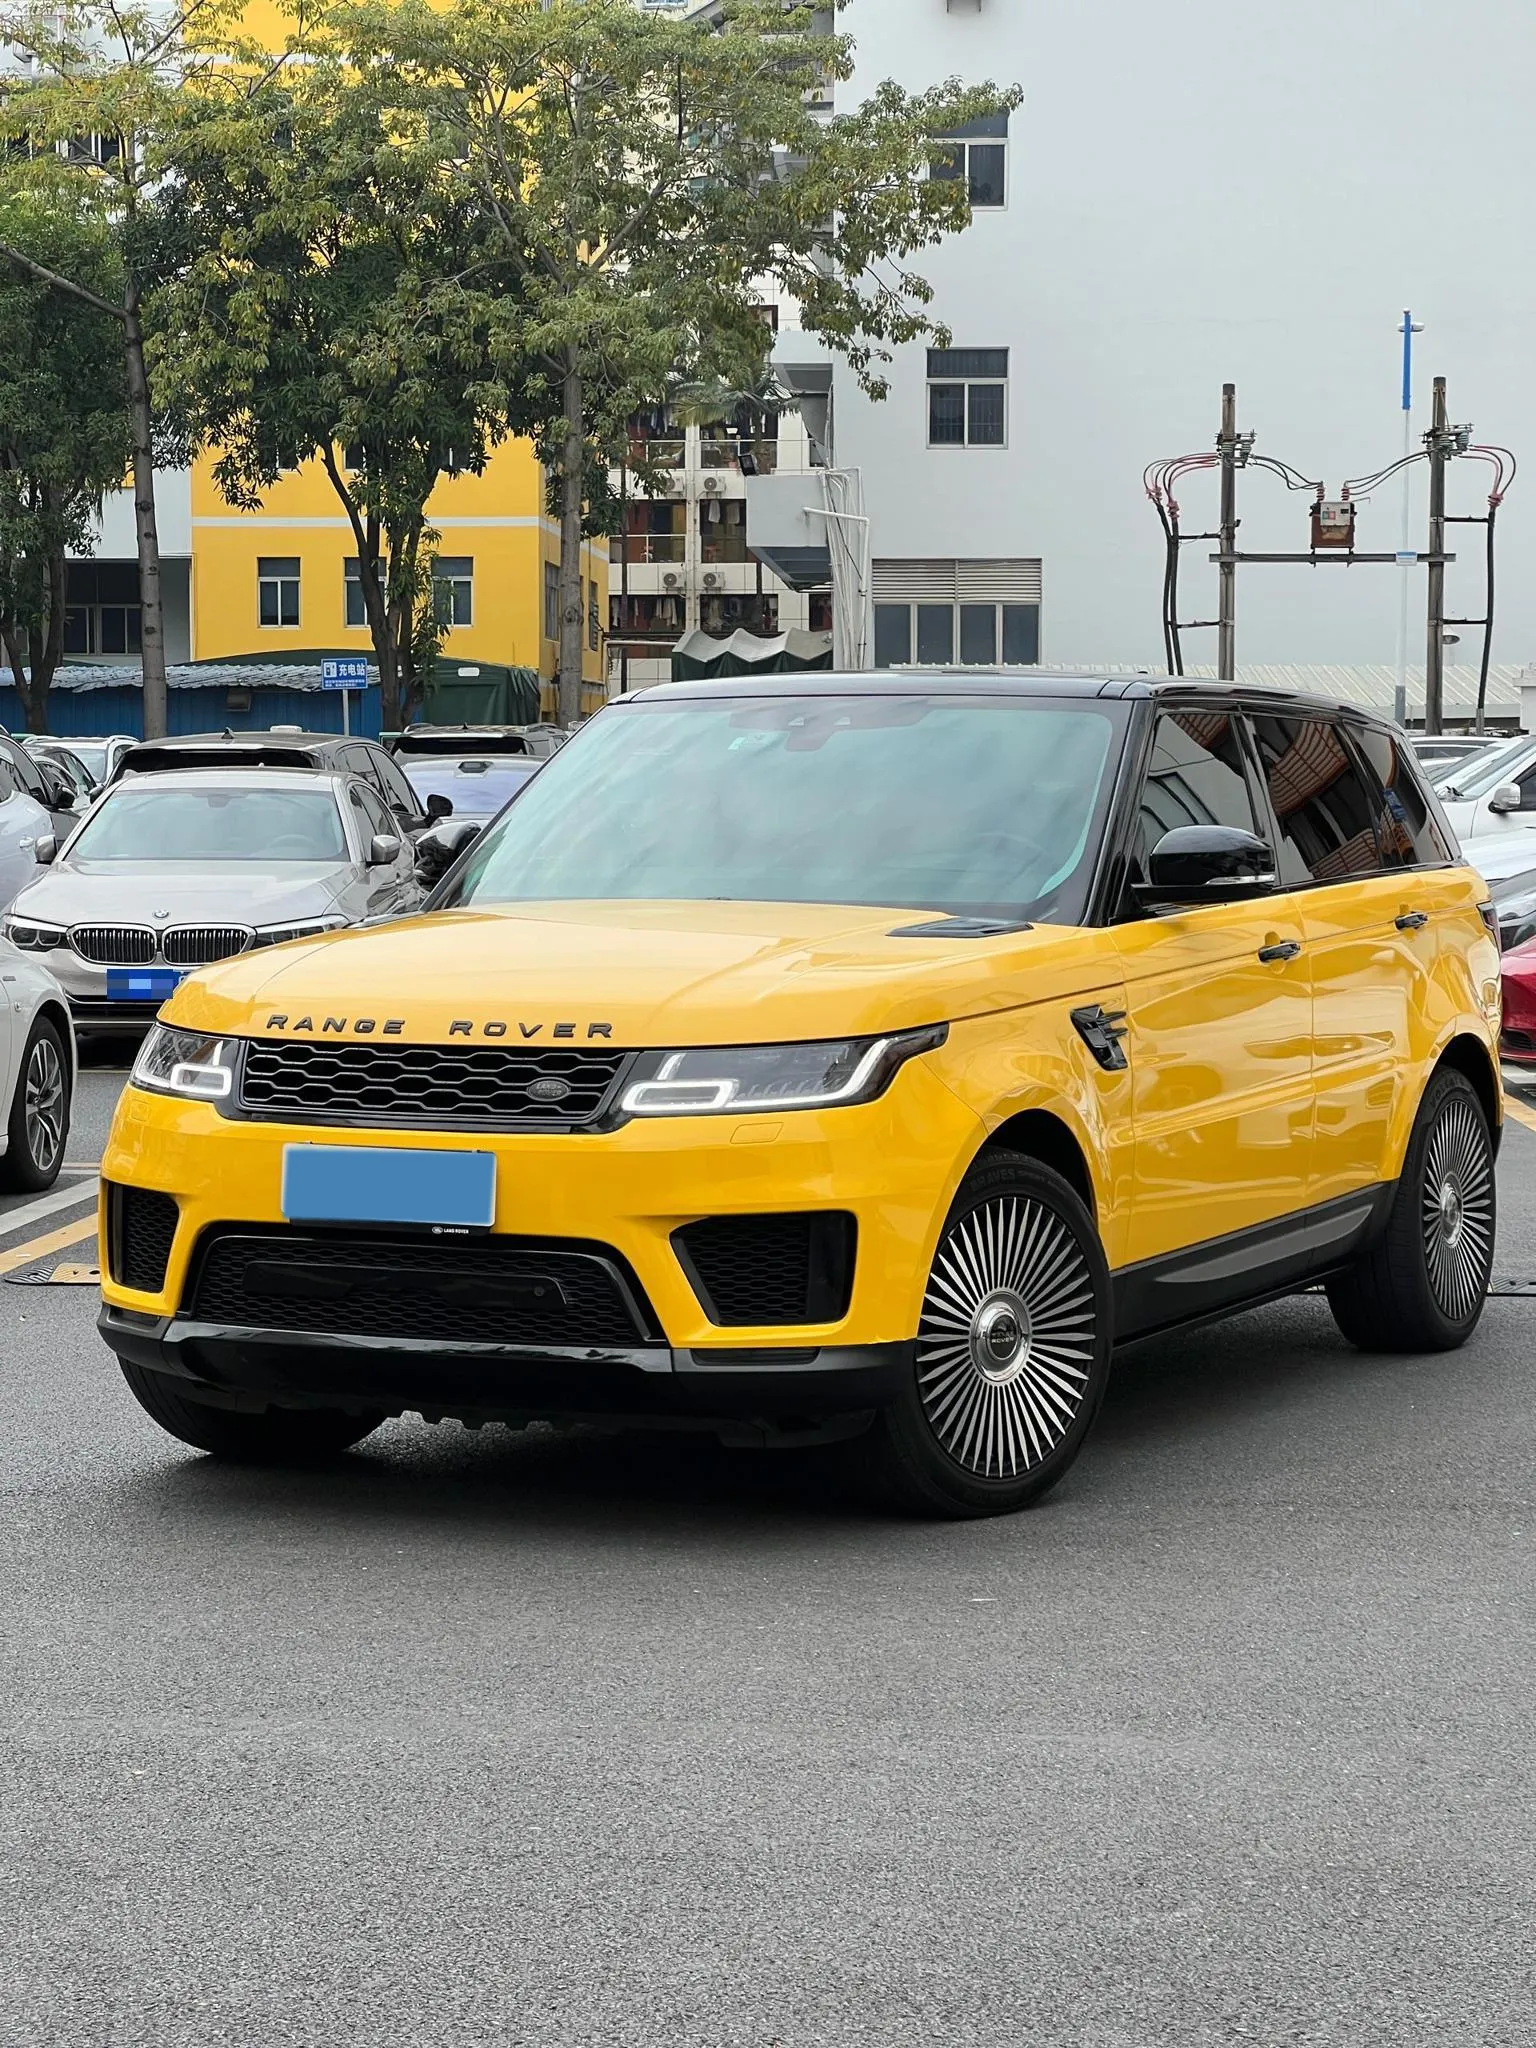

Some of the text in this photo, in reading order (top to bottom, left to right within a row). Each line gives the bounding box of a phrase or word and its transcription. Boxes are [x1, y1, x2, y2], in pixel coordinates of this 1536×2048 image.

[338, 663, 365, 676] 充电站
[266, 1014, 613, 1039] RANGE ROVER
[991, 1336, 1014, 1344] ROVER
